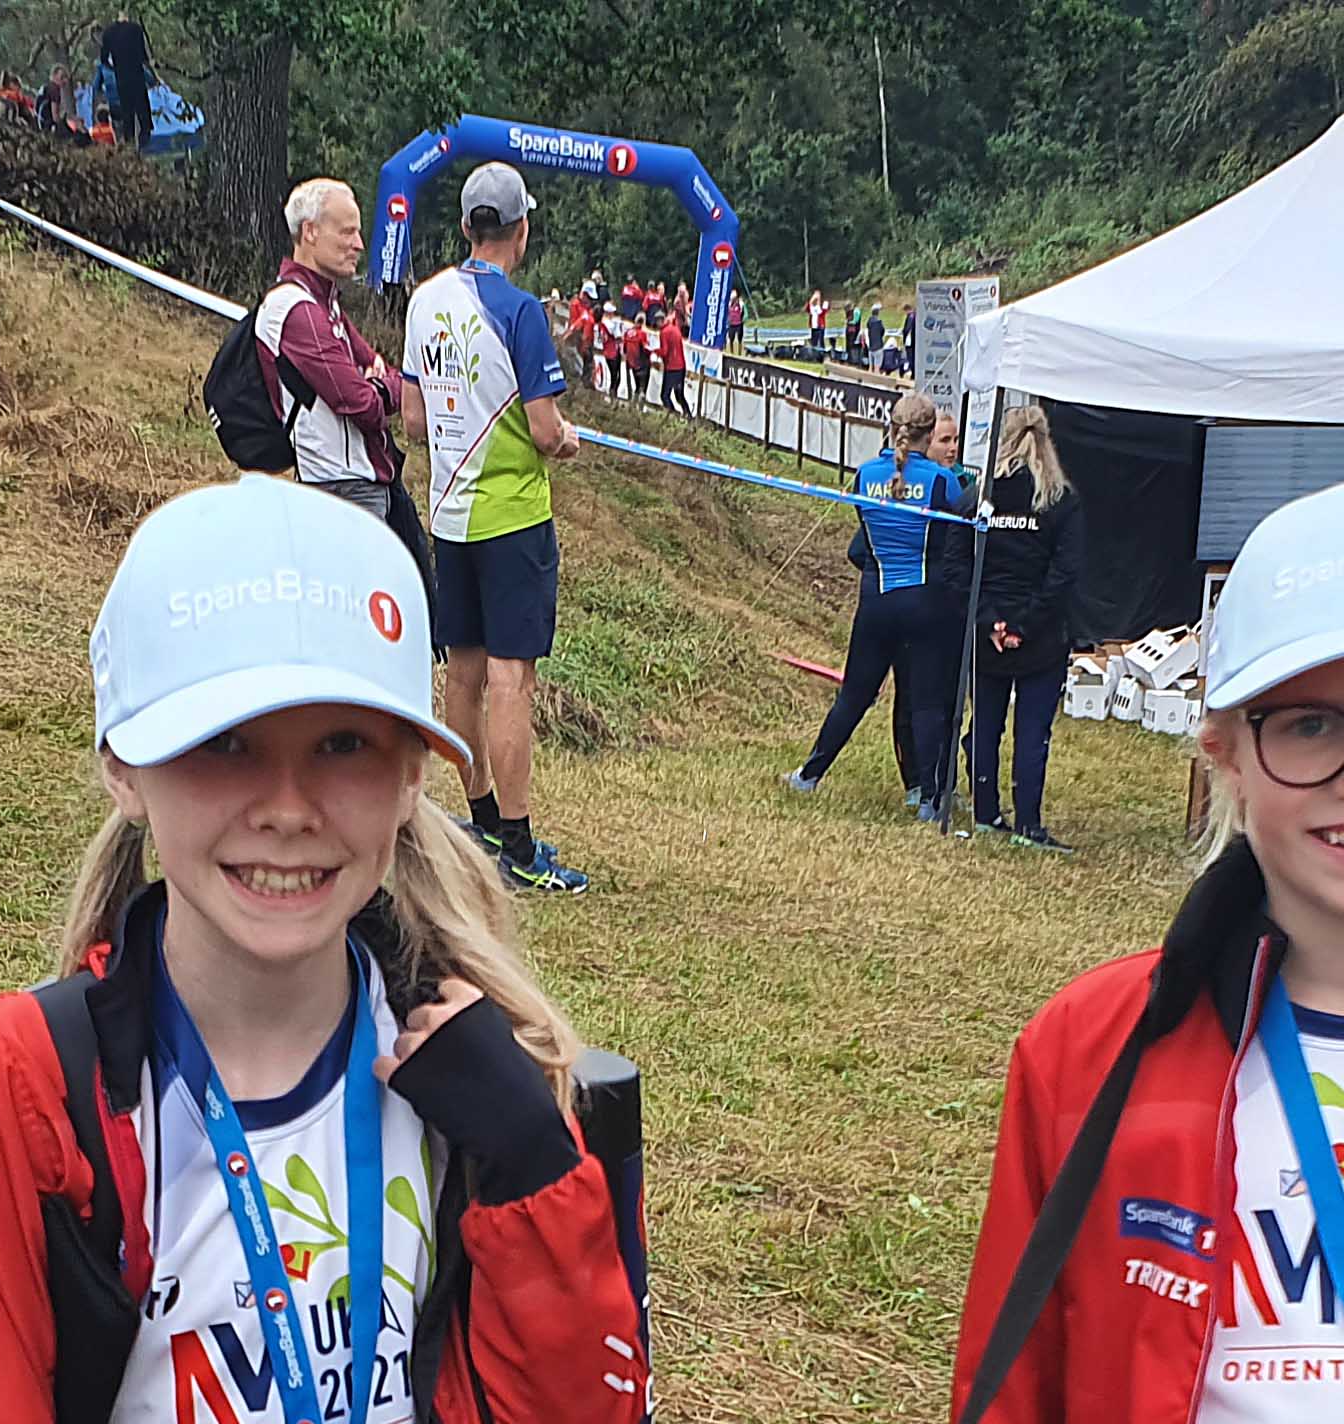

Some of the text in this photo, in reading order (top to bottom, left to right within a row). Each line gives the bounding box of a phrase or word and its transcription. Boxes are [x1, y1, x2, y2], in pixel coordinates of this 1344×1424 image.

[509, 127, 605, 161] SpareBank
[381, 219, 397, 284] areBank
[866, 483, 925, 499] VARGG
[167, 568, 368, 630] SpareBank
